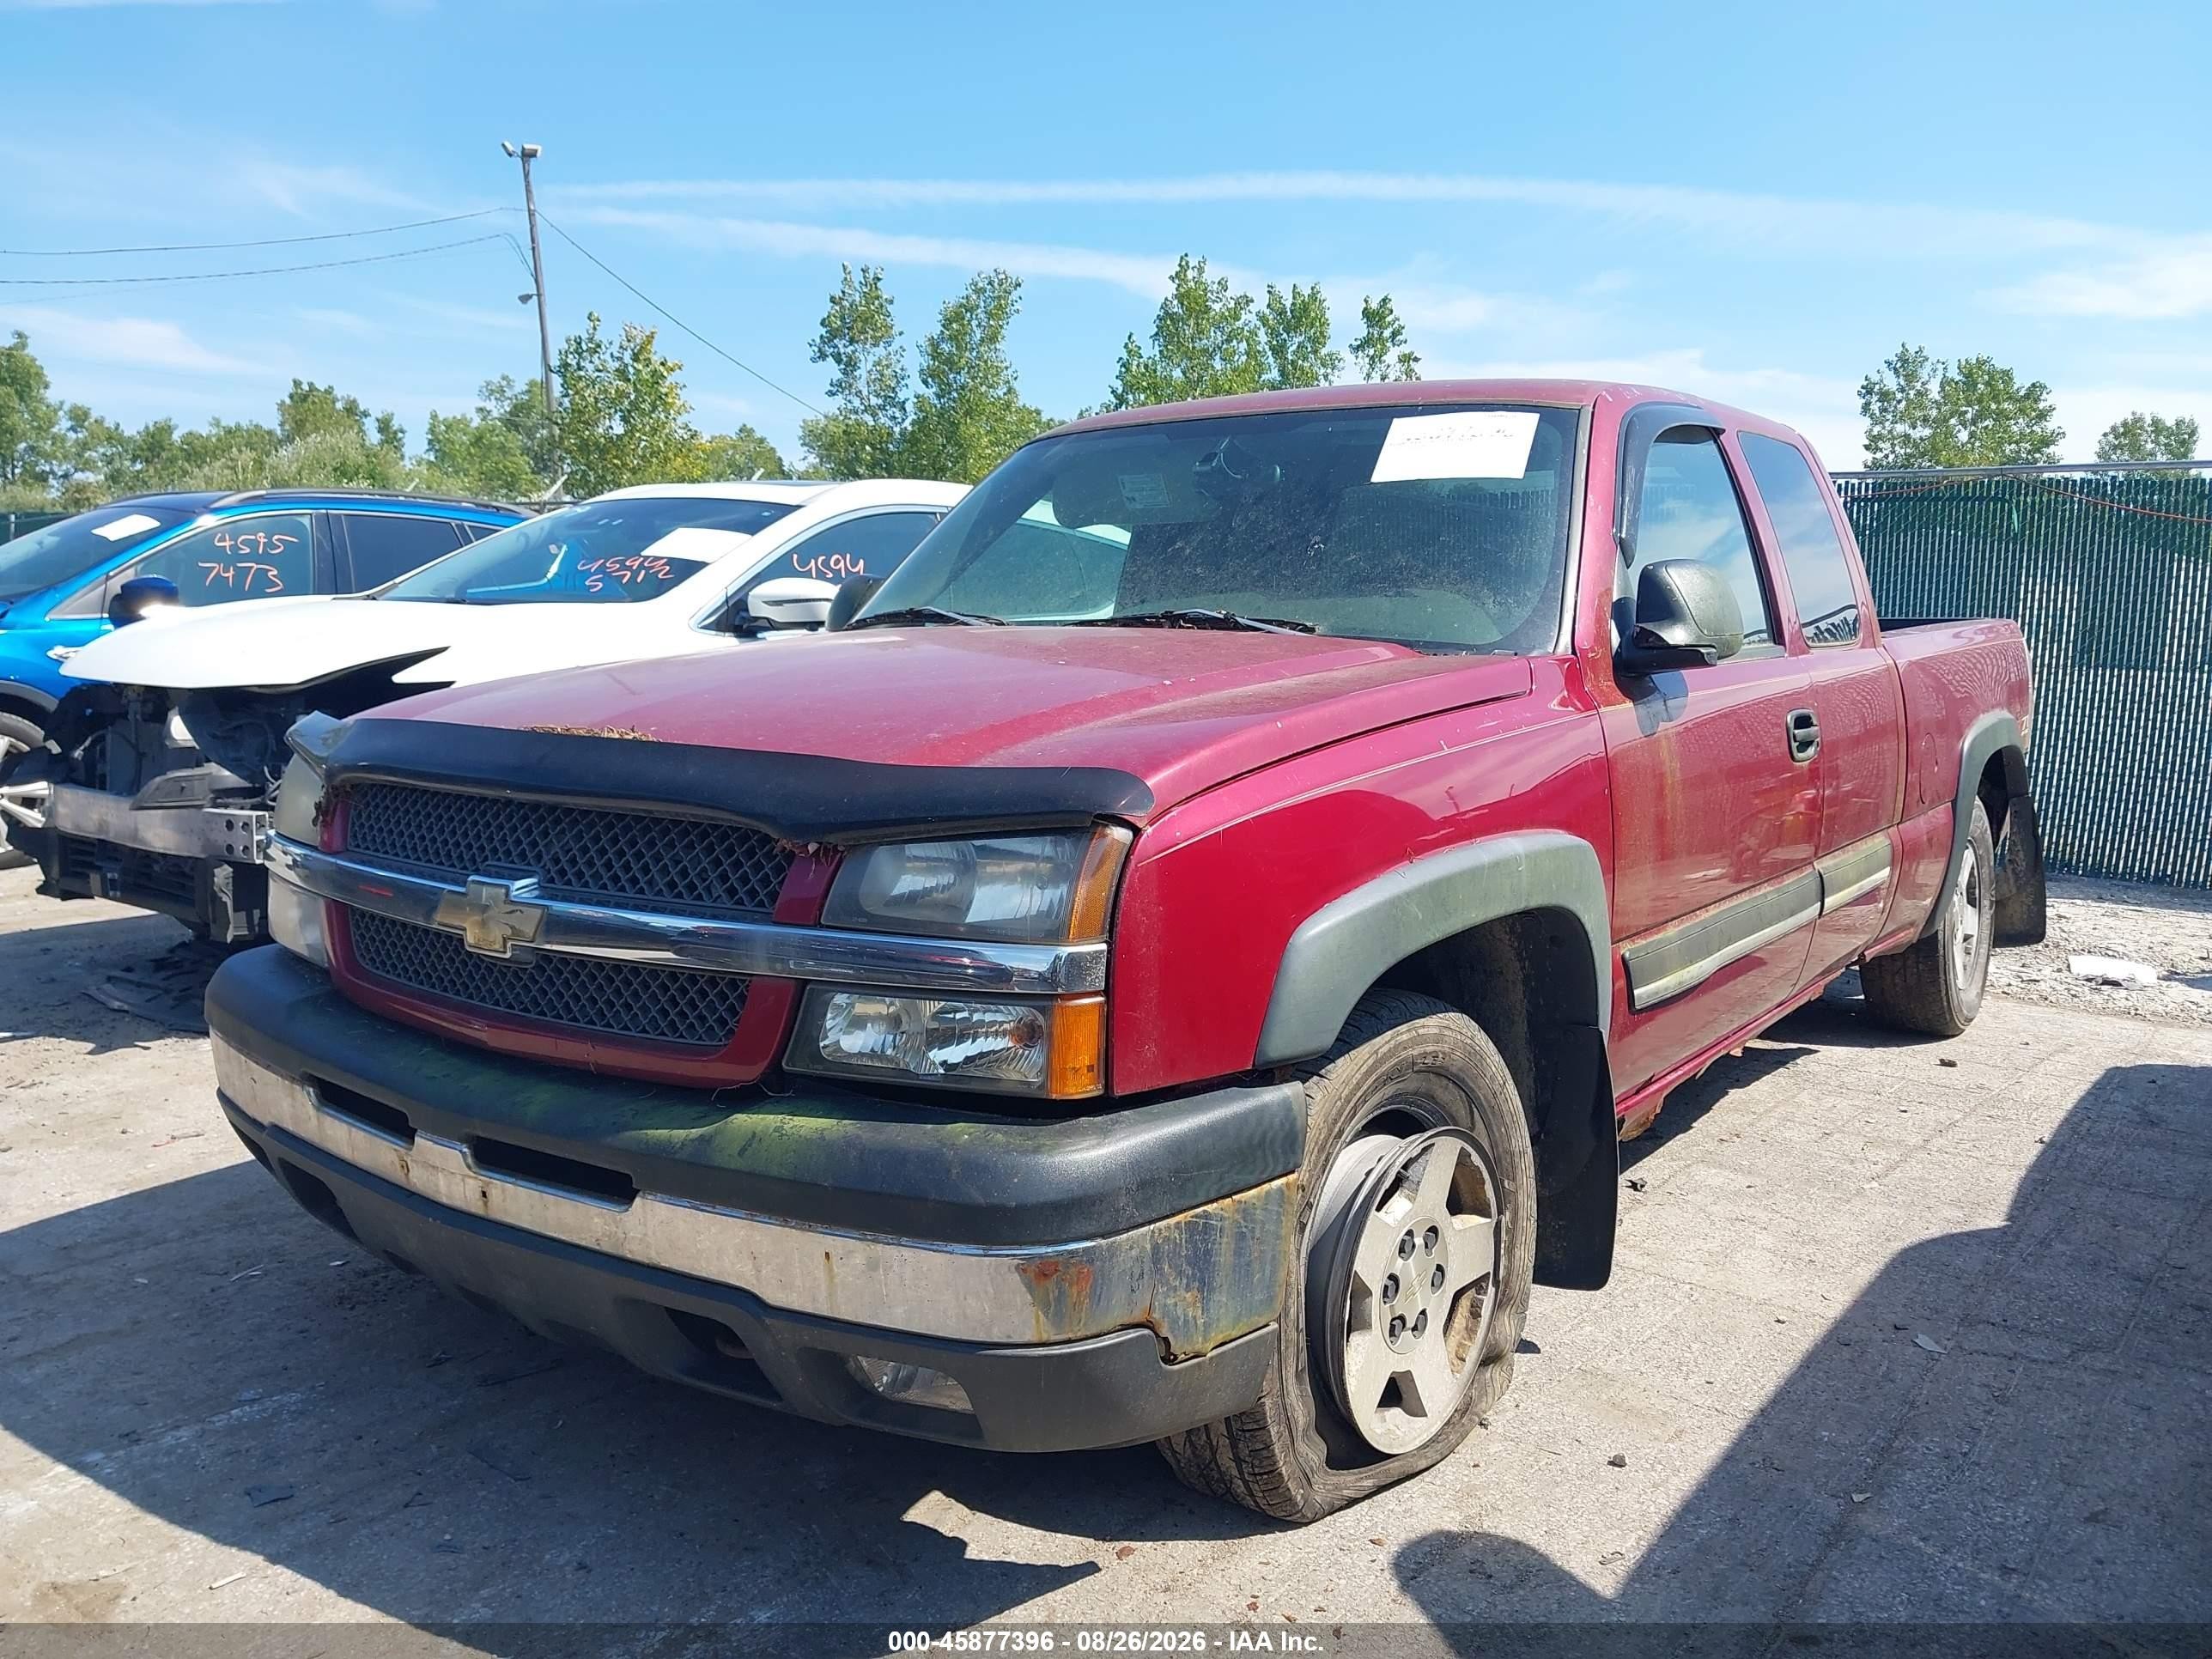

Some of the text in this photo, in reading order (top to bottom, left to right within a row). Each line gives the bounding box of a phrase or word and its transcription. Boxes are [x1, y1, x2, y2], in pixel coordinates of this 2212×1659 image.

[214, 531, 300, 555] 4595
[198, 561, 284, 592] 7473
[793, 552, 865, 579] 4594
